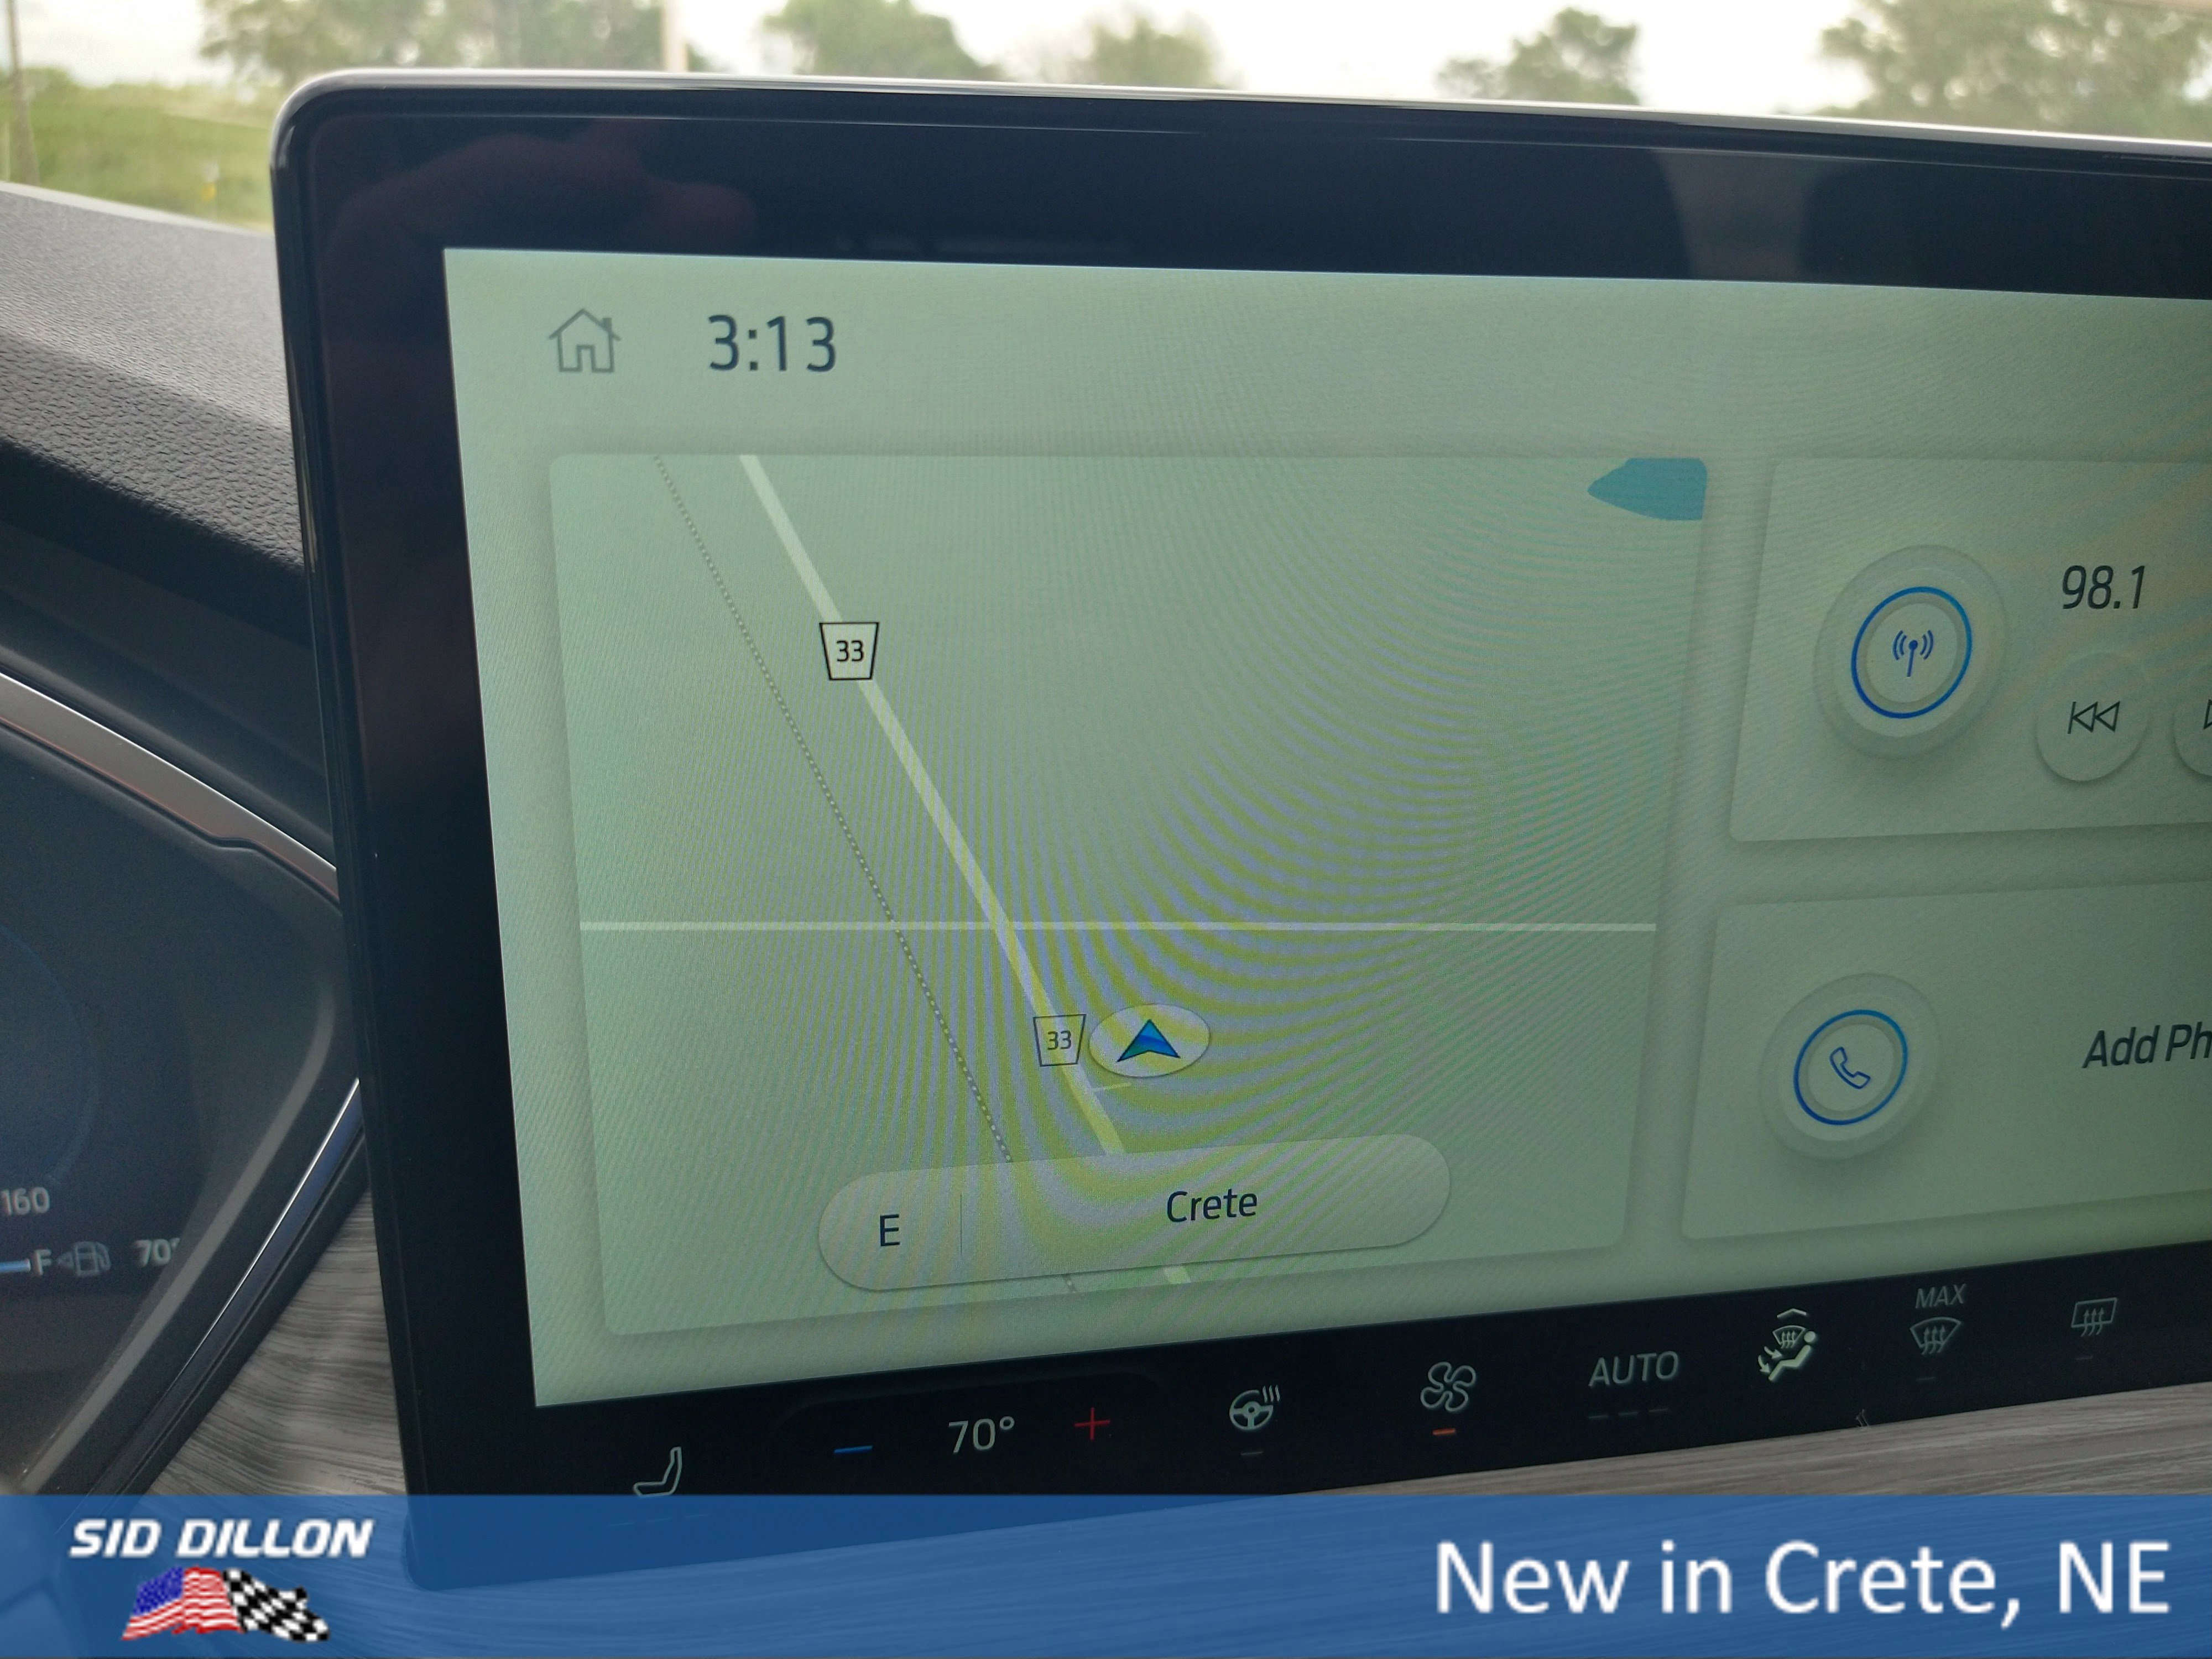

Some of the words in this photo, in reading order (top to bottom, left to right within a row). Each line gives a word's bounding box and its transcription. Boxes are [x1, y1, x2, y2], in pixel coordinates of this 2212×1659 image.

[708, 314, 836, 372] 3:13
[2062, 565, 2146, 609] 98.1
[836, 640, 864, 662] 33
[1047, 1030, 1072, 1051] 33
[2081, 1024, 2161, 1068] Add
[2, 1186, 50, 1215] 160
[1166, 1187, 1258, 1223] Crete
[879, 1214, 900, 1247] E
[32, 1249, 52, 1276] F
[1914, 1283, 1966, 1310] MAX
[1588, 1350, 1679, 1388] AUTO
